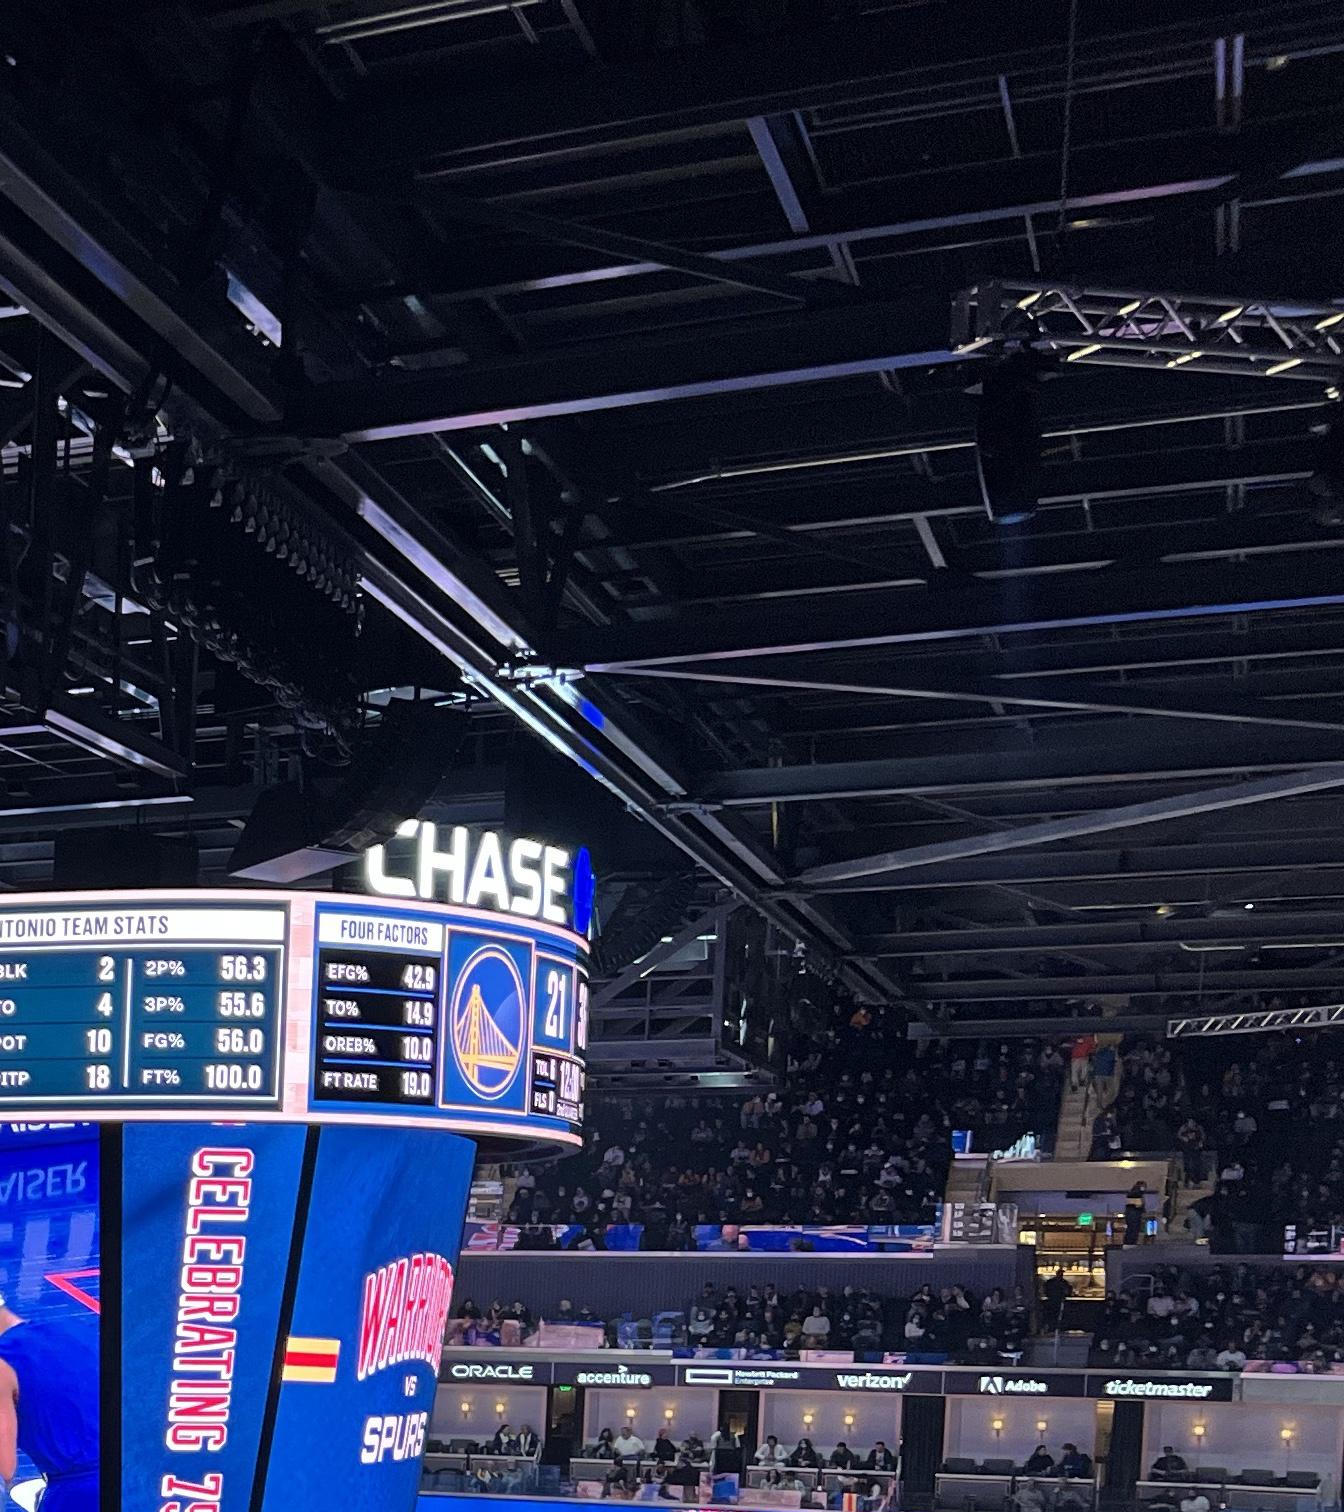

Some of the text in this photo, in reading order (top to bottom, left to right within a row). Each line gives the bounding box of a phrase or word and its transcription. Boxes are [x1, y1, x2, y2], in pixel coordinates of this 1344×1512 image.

[365, 818, 571, 925] CHASE
[61, 916, 109, 938] TEAM
[113, 915, 169, 936] STATS
[99, 955, 115, 981] 2
[144, 960, 186, 977] 2P%
[220, 955, 266, 981] 56.3
[97, 992, 113, 1017] 4
[143, 997, 185, 1013] 3P%
[219, 992, 265, 1017] 55.6
[165, 1146, 255, 1452] CELEBRATING
[451, 1363, 534, 1379] ORACLE
[576, 1368, 651, 1385] accenture
[836, 1373, 909, 1390] verizon
[1005, 1379, 1047, 1393] Adobe
[1105, 1380, 1212, 1398] ticketmaster
[359, 1410, 427, 1465] SPURS
